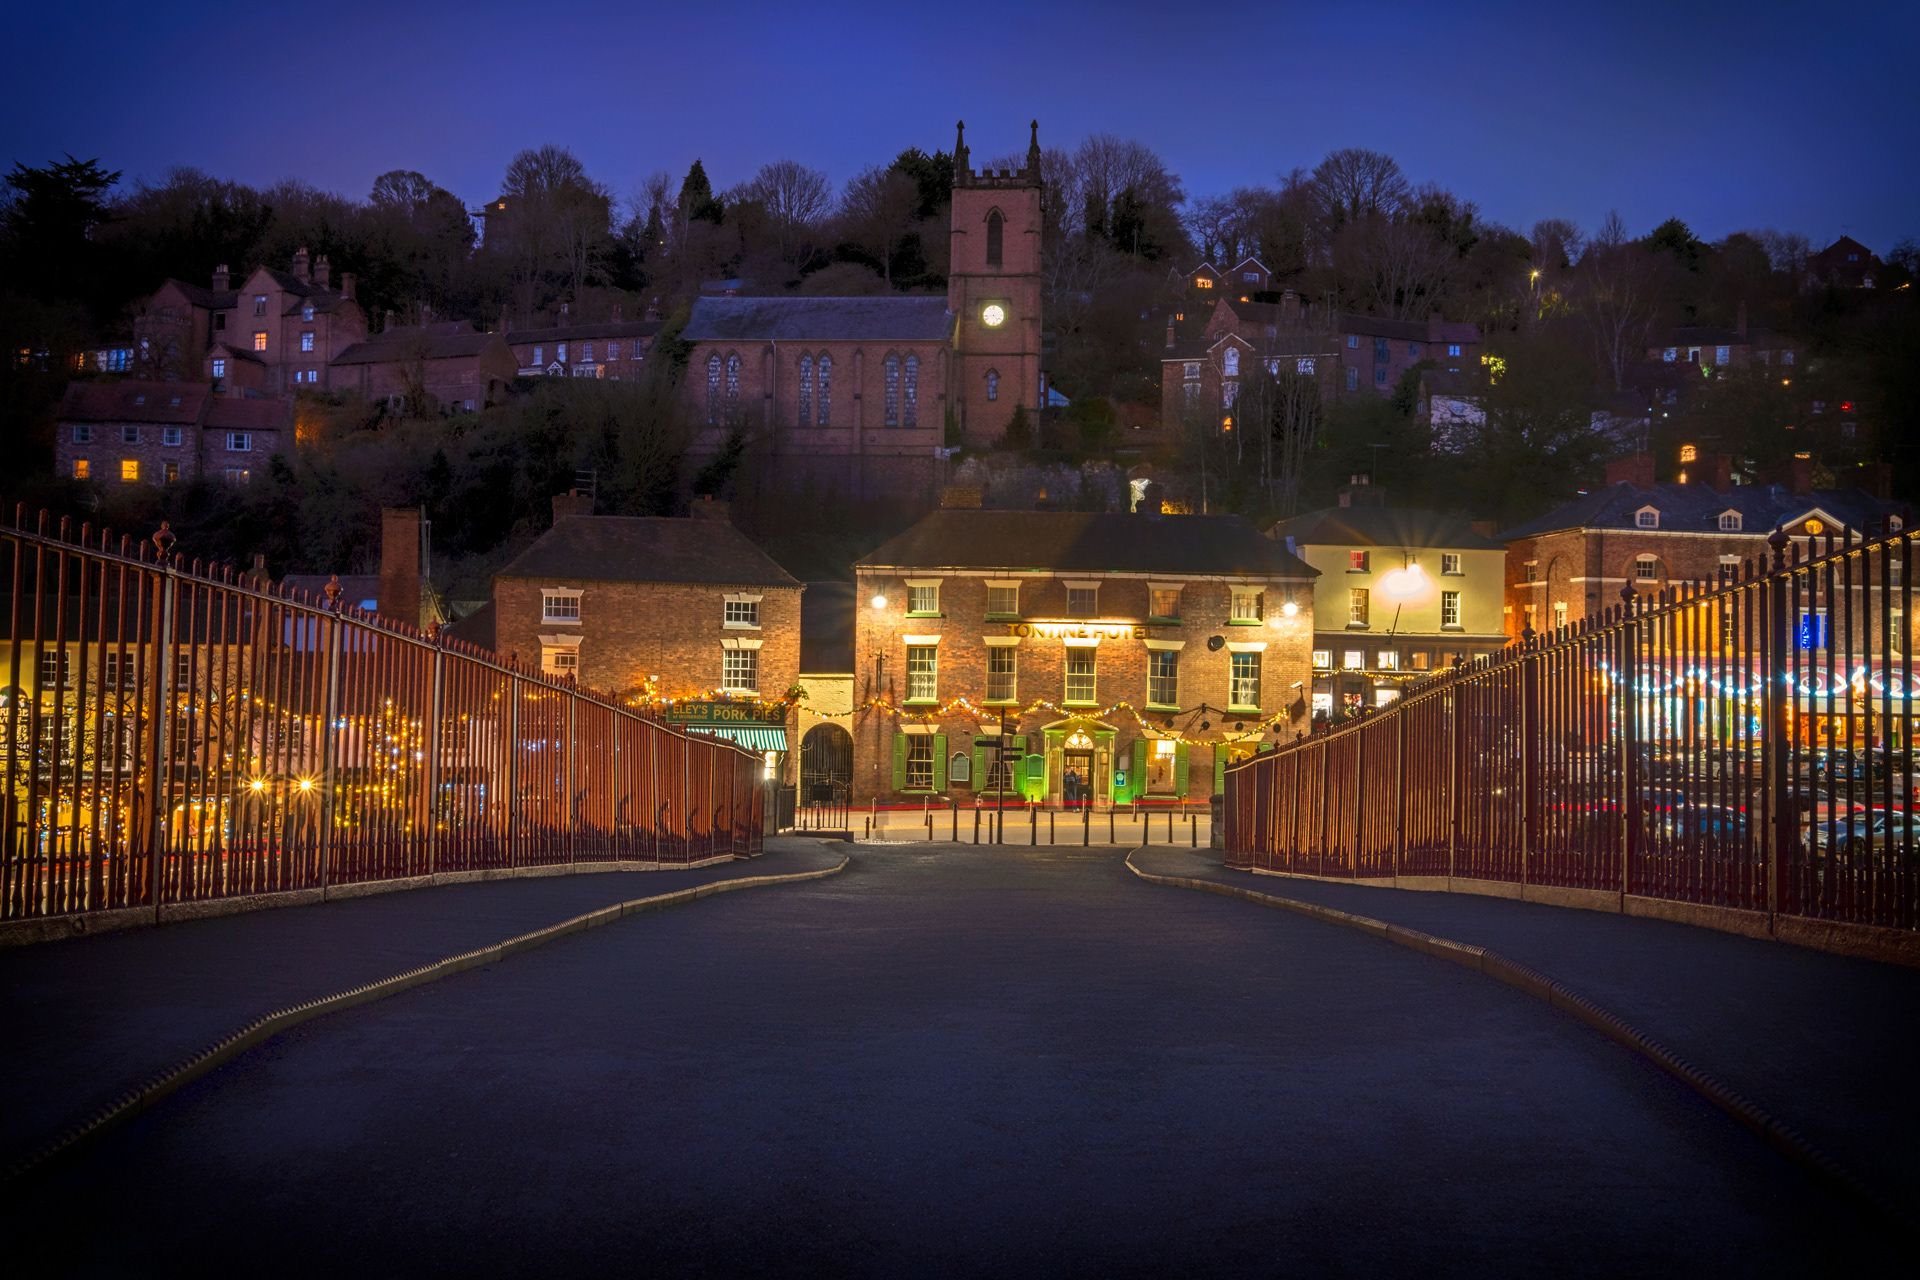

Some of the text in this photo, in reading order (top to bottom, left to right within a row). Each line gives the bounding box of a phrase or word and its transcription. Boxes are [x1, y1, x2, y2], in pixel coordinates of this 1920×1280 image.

[1007, 623, 1088, 638] TONTINE
[672, 704, 708, 715] ELEY'S
[713, 709, 780, 721] PORK PIES
